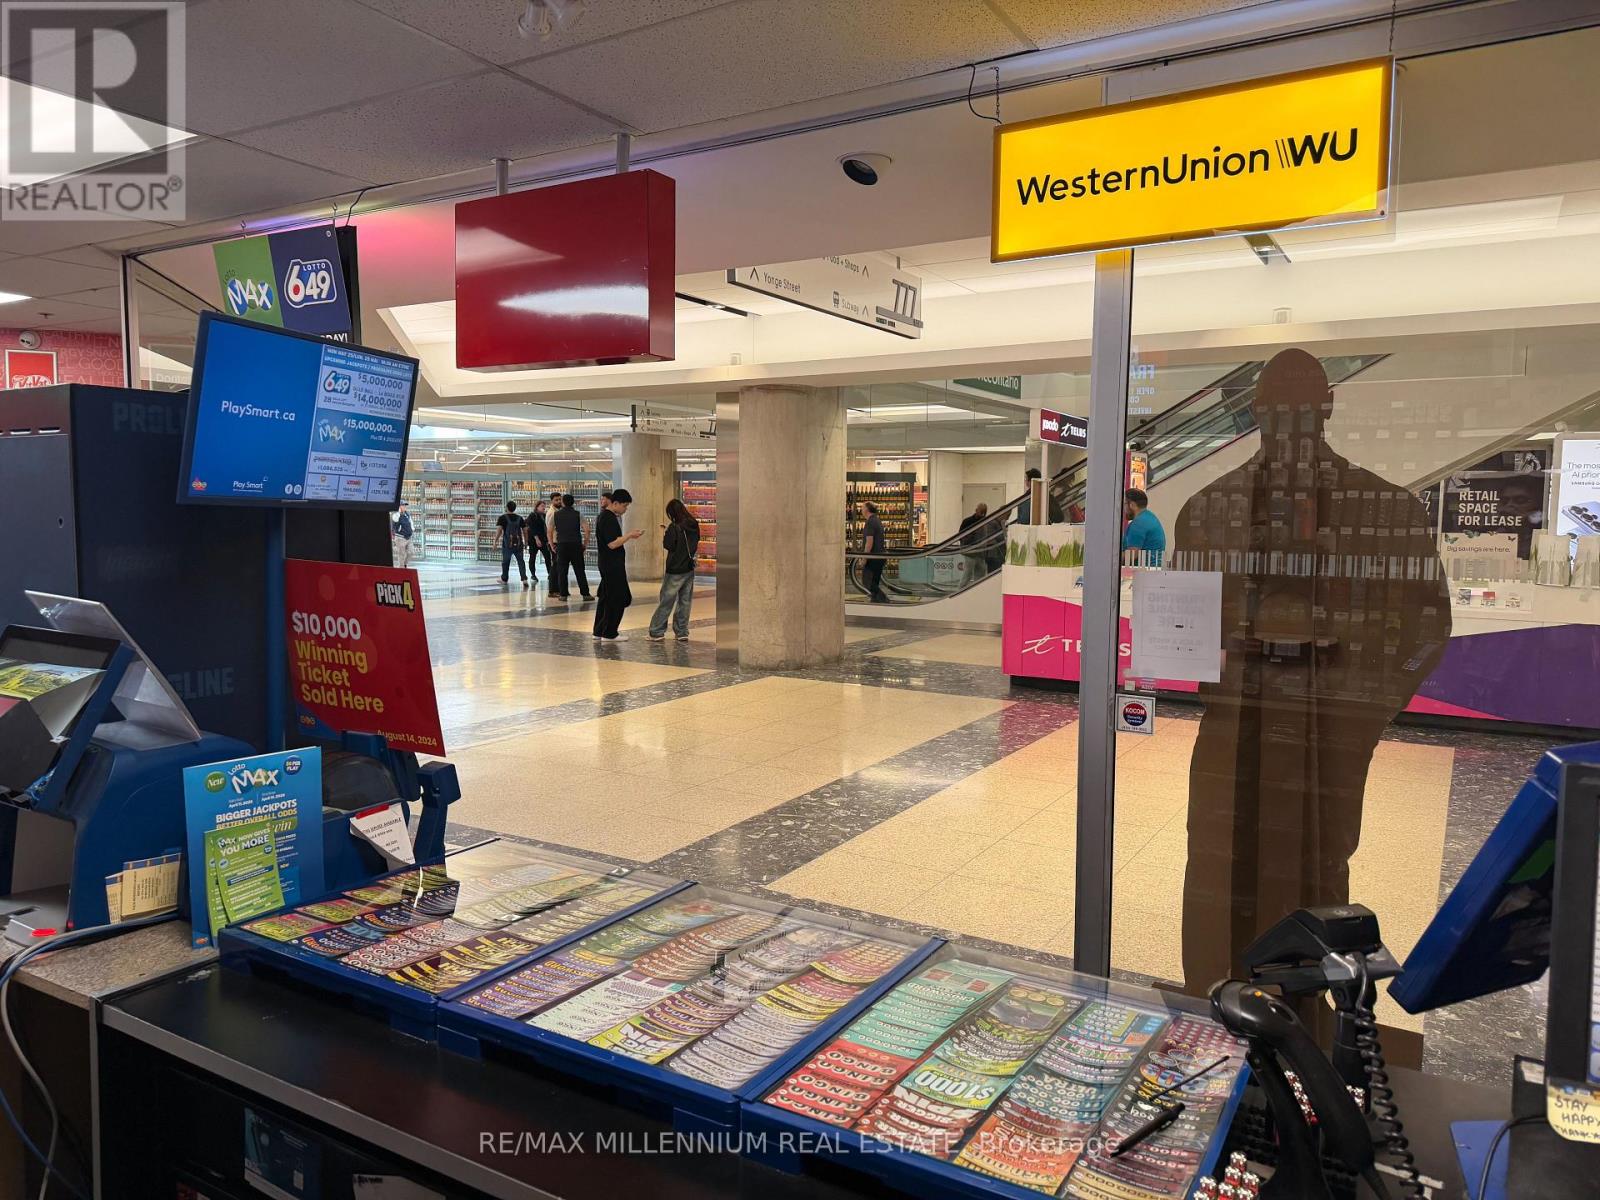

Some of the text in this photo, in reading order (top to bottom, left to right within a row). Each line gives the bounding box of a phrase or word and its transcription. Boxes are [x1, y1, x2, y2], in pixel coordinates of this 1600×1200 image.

[1017, 145, 1270, 206] WesternUnion
[303, 263, 326, 271] LOTTO
[763, 271, 801, 294] Yonge Street
[892, 278, 917, 318] 777
[358, 373, 403, 390] $5,000,000
[221, 400, 296, 421] PlaySmart.ca
[353, 392, 402, 409] $14,000,000
[343, 418, 393, 433] $15,000,000
[1459, 490, 1500, 501] RETAIL
[1458, 503, 1498, 514] SPACE
[1457, 515, 1523, 527] FOR LEASE
[292, 609, 362, 641] $10,000
[295, 640, 369, 674] Winning
[298, 661, 351, 688] Ticket
[301, 683, 385, 713] Sold Here
[376, 729, 438, 747] August 14, 2024
[227, 763, 246, 776] Lotto
[231, 768, 279, 795] MAX
[216, 799, 298, 824] BIGGER JACKPOTS
[244, 813, 277, 825] OVERALL
[277, 808, 298, 817] ODDS
[220, 845, 240, 857] YOU
[241, 834, 270, 850] MORE
[818, 1060, 888, 1086] BINGO
[828, 1051, 897, 1076] BINGO
[799, 1074, 871, 1102] BINGO
[1043, 1073, 1096, 1094] ULTRA
[789, 1084, 862, 1112] BINGO
[1554, 1096, 1588, 1112] STAY
